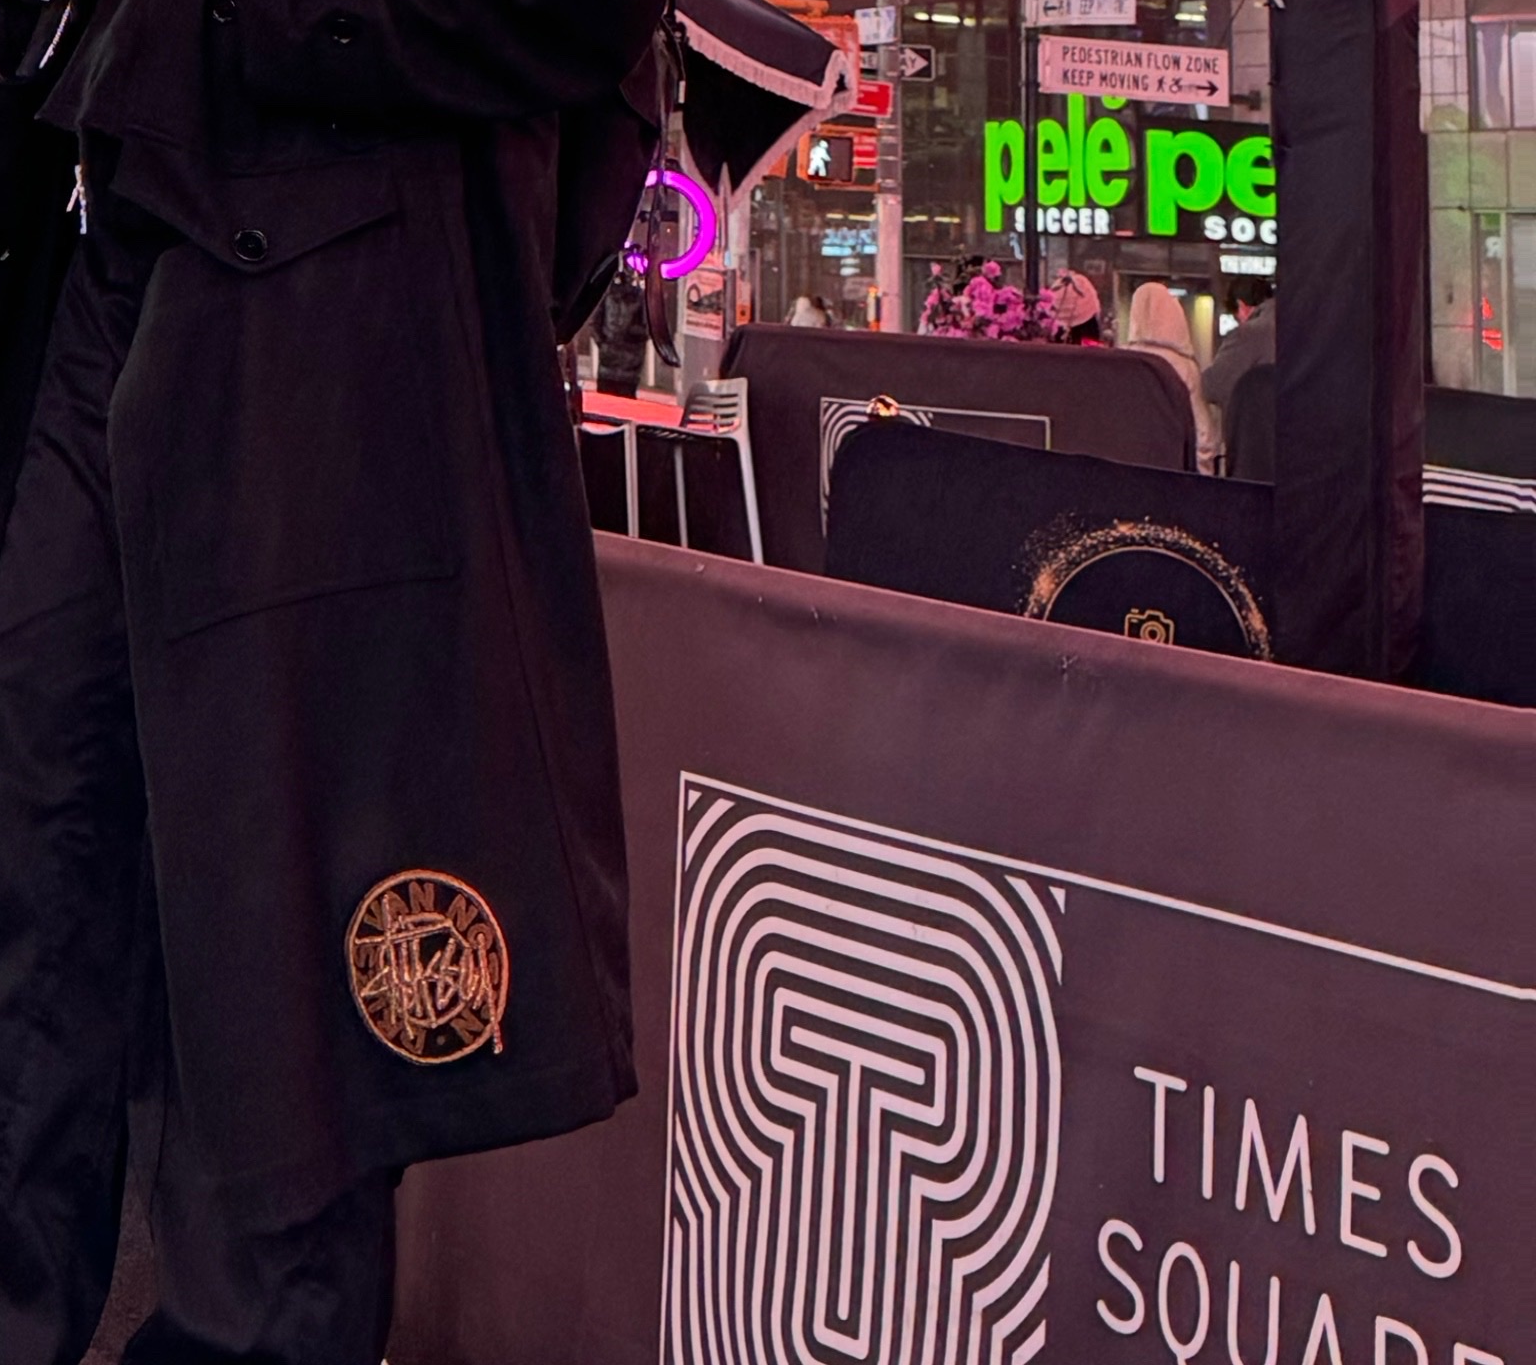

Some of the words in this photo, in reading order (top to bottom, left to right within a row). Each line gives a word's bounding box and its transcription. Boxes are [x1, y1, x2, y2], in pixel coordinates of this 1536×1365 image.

[1062, 45, 1143, 70] PEDESTRIAN
[1147, 52, 1182, 71] FLOW
[1186, 57, 1220, 75] ZONE
[1062, 68, 1094, 86] KEEP
[1099, 73, 1150, 92] MOVING
[1015, 207, 1110, 235] SCCER
[1133, 1066, 1463, 1279] TIMES
[1096, 1219, 1506, 1365] SQUA
